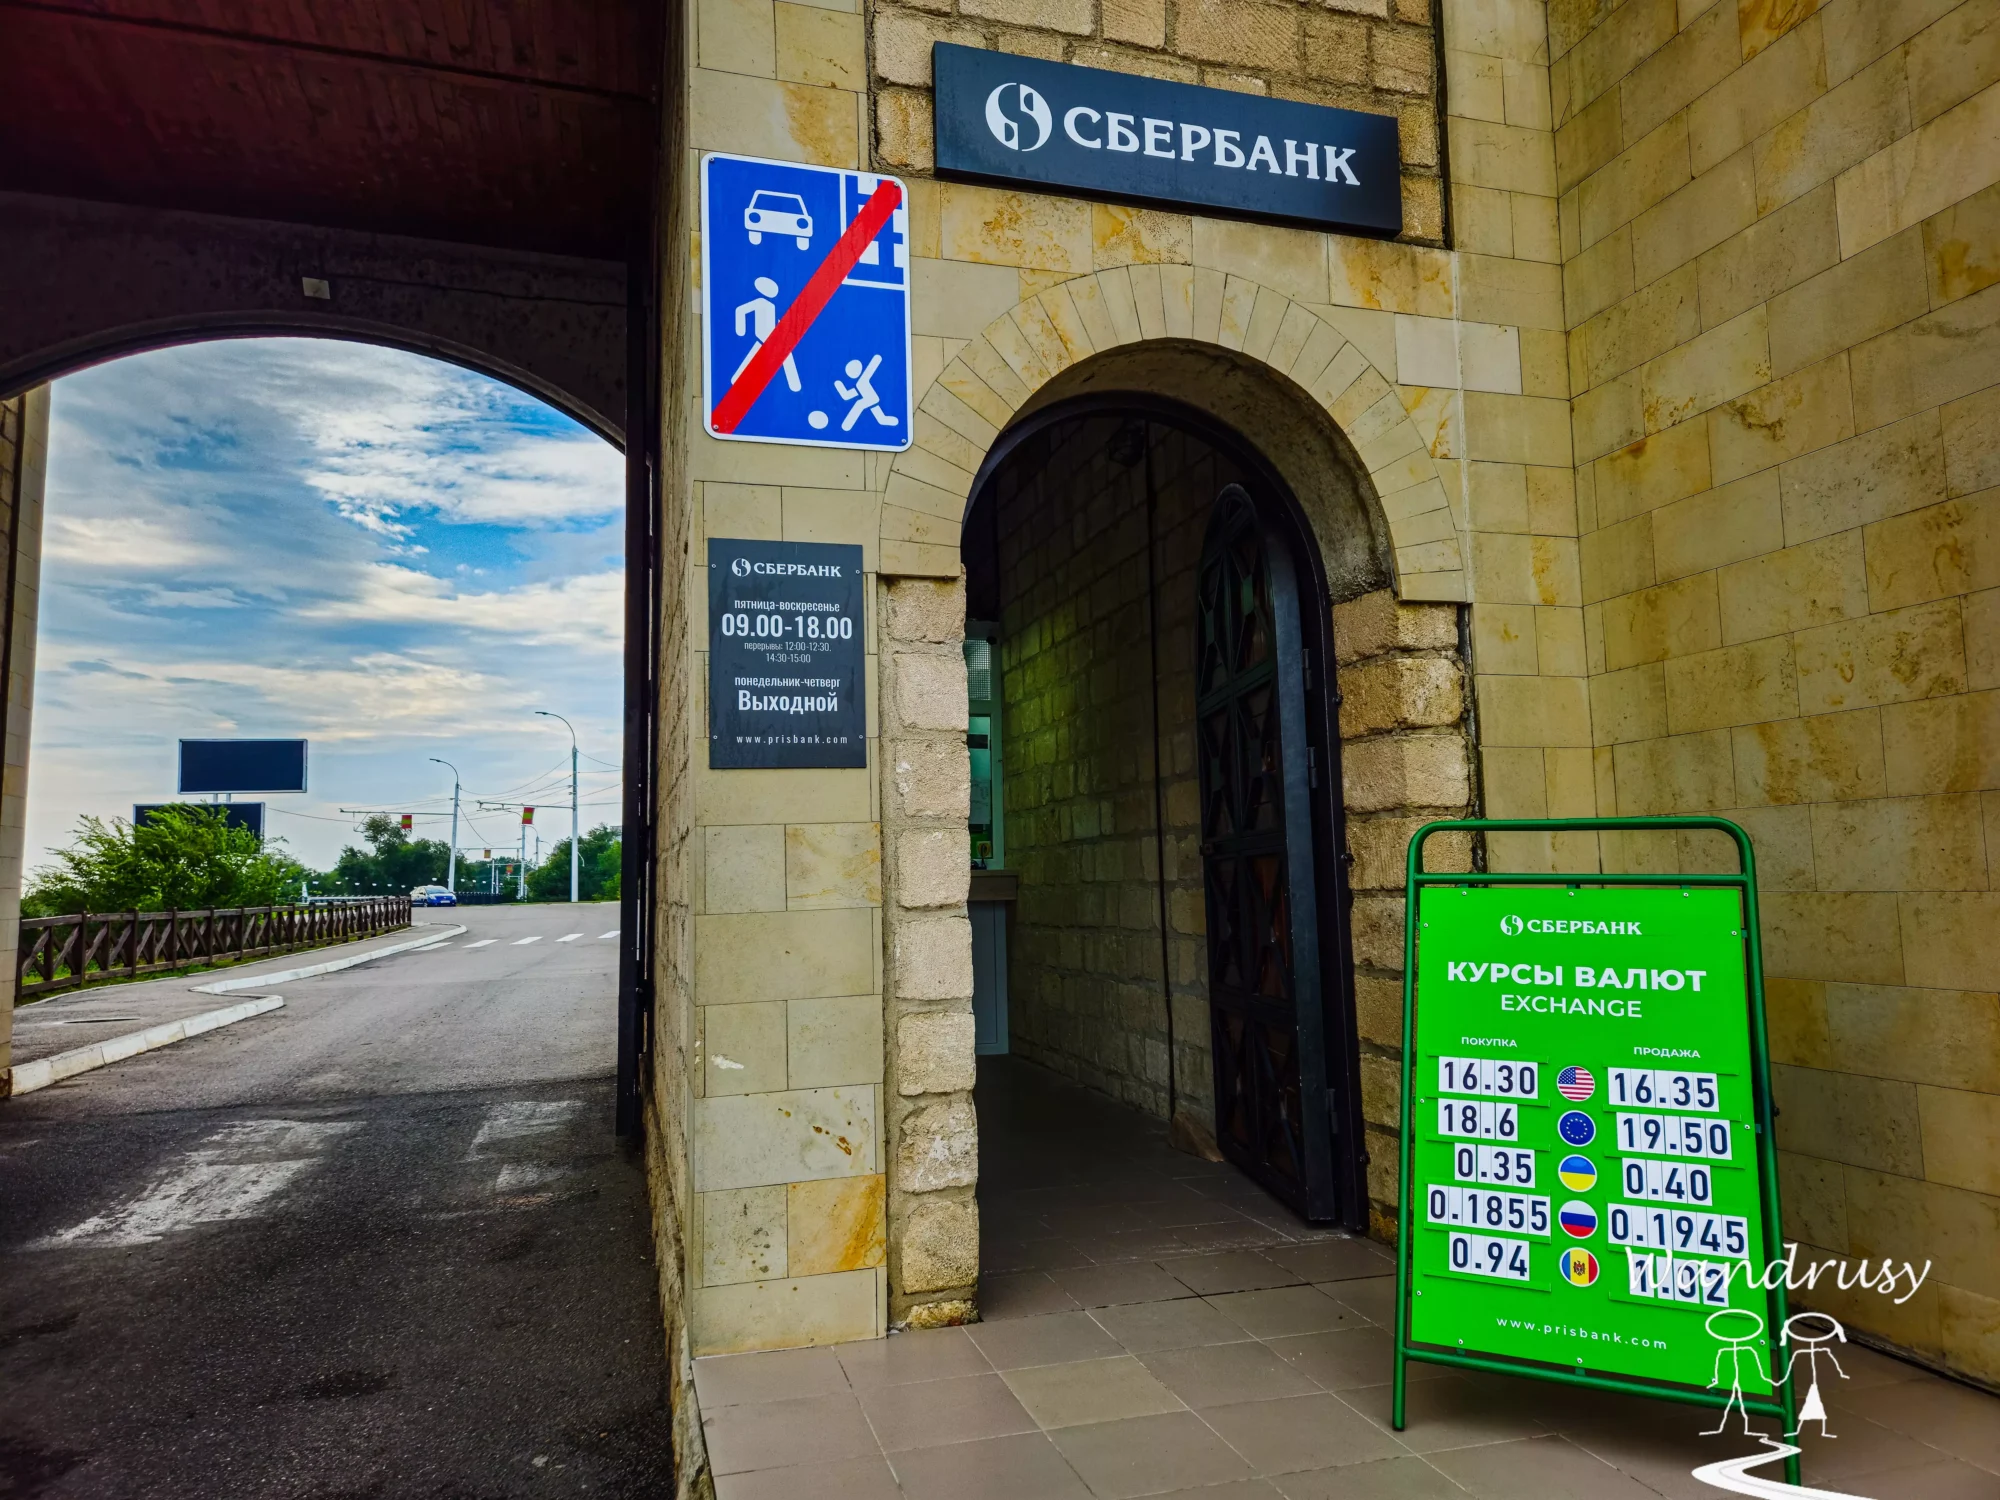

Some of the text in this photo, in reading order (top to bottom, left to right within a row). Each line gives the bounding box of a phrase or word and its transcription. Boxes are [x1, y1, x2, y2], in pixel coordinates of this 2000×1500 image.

[1063, 106, 1361, 186] СБЕРБАНК
[753, 562, 842, 577] СБЕРБАНК
[734, 600, 840, 612] пятница-воскресенье
[721, 613, 853, 639] 09.00-18.00
[766, 653, 811, 663] 14:30-15:00
[734, 676, 841, 688] понедельник-четверг
[738, 690, 838, 715] Выходной
[736, 734, 848, 745] www.prisbank.com
[1527, 919, 1642, 935] СБЕРБАНК
[1447, 961, 1707, 992] КУРСЫ ВАЛЮТ
[1501, 995, 1642, 1018] EXCHANGE
[1461, 1036, 1518, 1048] ПОКУПКА
[1633, 1046, 1701, 1059] ПРОДАЖА
[1444, 1061, 1536, 1099] 16.30
[1614, 1072, 1716, 1109] 16.35
[1443, 1104, 1516, 1137] 18.6
[1622, 1118, 1729, 1155] 19.50
[1457, 1147, 1533, 1184] 0.35
[1626, 1163, 1709, 1202] 0.40
[1430, 1189, 1548, 1232] 0.1855
[1610, 1208, 1746, 1254] 0.1945
[1452, 1237, 1528, 1277] 0.94
[1496, 1318, 1668, 1350] www.prisbank.com
